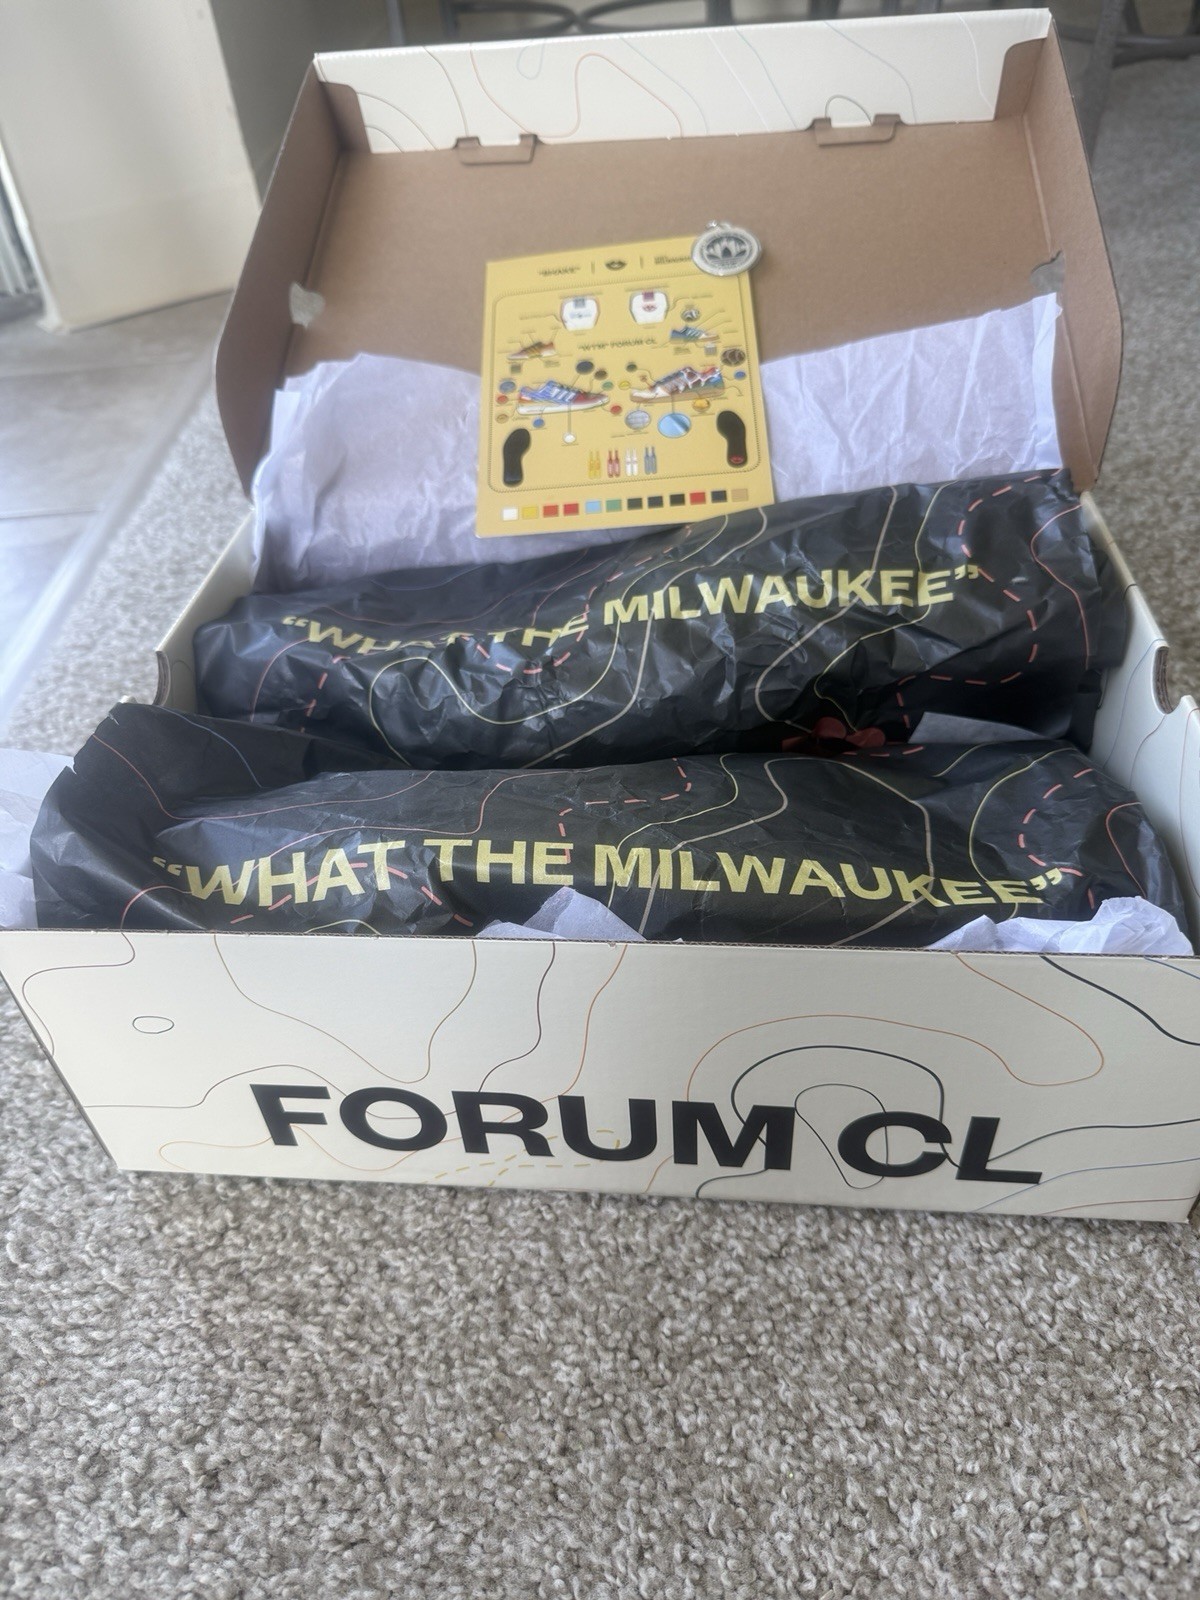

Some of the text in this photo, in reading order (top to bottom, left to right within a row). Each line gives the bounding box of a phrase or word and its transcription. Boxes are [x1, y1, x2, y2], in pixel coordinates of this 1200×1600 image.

[603, 564, 979, 626] MILWAUKEE”
[151, 838, 1064, 908] “WHAT THE MILWAUKEE”
[249, 1083, 1043, 1185] FORUM CL
